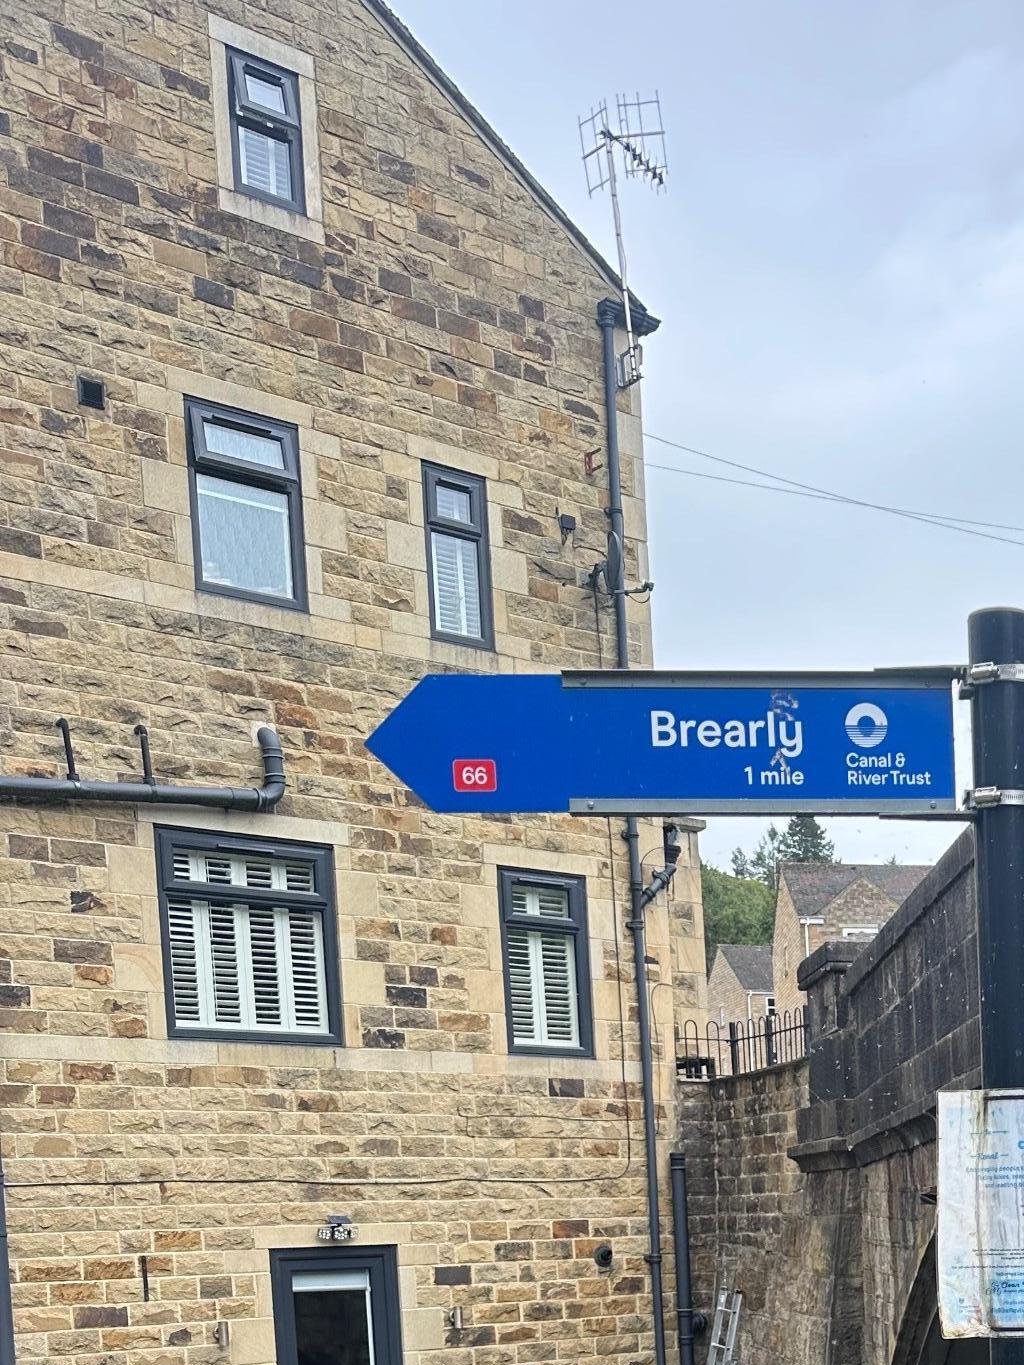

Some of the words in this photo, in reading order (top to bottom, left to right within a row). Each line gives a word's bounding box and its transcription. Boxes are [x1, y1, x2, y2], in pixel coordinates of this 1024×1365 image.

[650, 710, 803, 758] Brearly
[846, 752, 892, 768] Canal
[895, 752, 906, 768] &
[462, 766, 488, 785] 66
[743, 766, 753, 785] 1
[760, 766, 805, 786] mile
[847, 770, 889, 785] River
[889, 770, 932, 785] Trust
